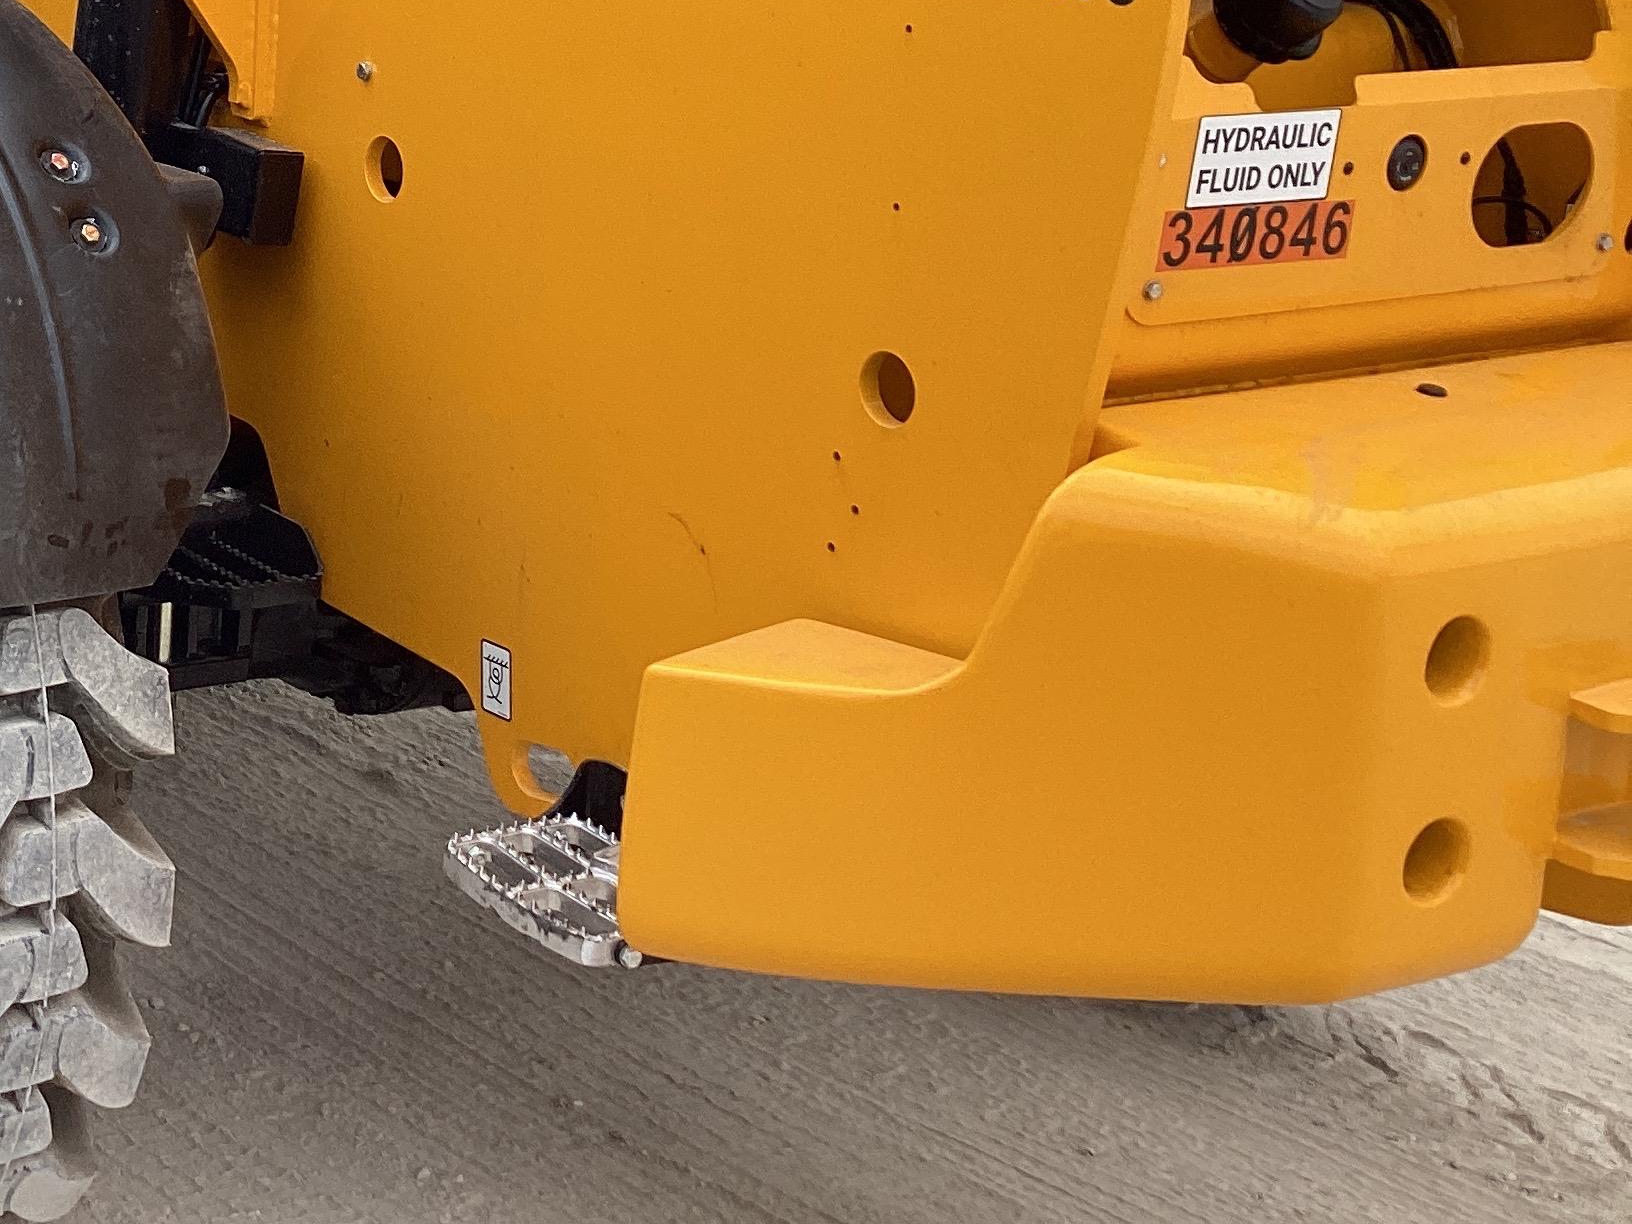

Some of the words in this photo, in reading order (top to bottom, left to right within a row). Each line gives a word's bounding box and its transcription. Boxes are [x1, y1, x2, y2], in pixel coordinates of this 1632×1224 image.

[1201, 122, 1333, 154] HYDRAULIC
[1196, 166, 1261, 194] FLUID
[1267, 161, 1326, 189] ONLY
[1162, 201, 1350, 267] 340846
